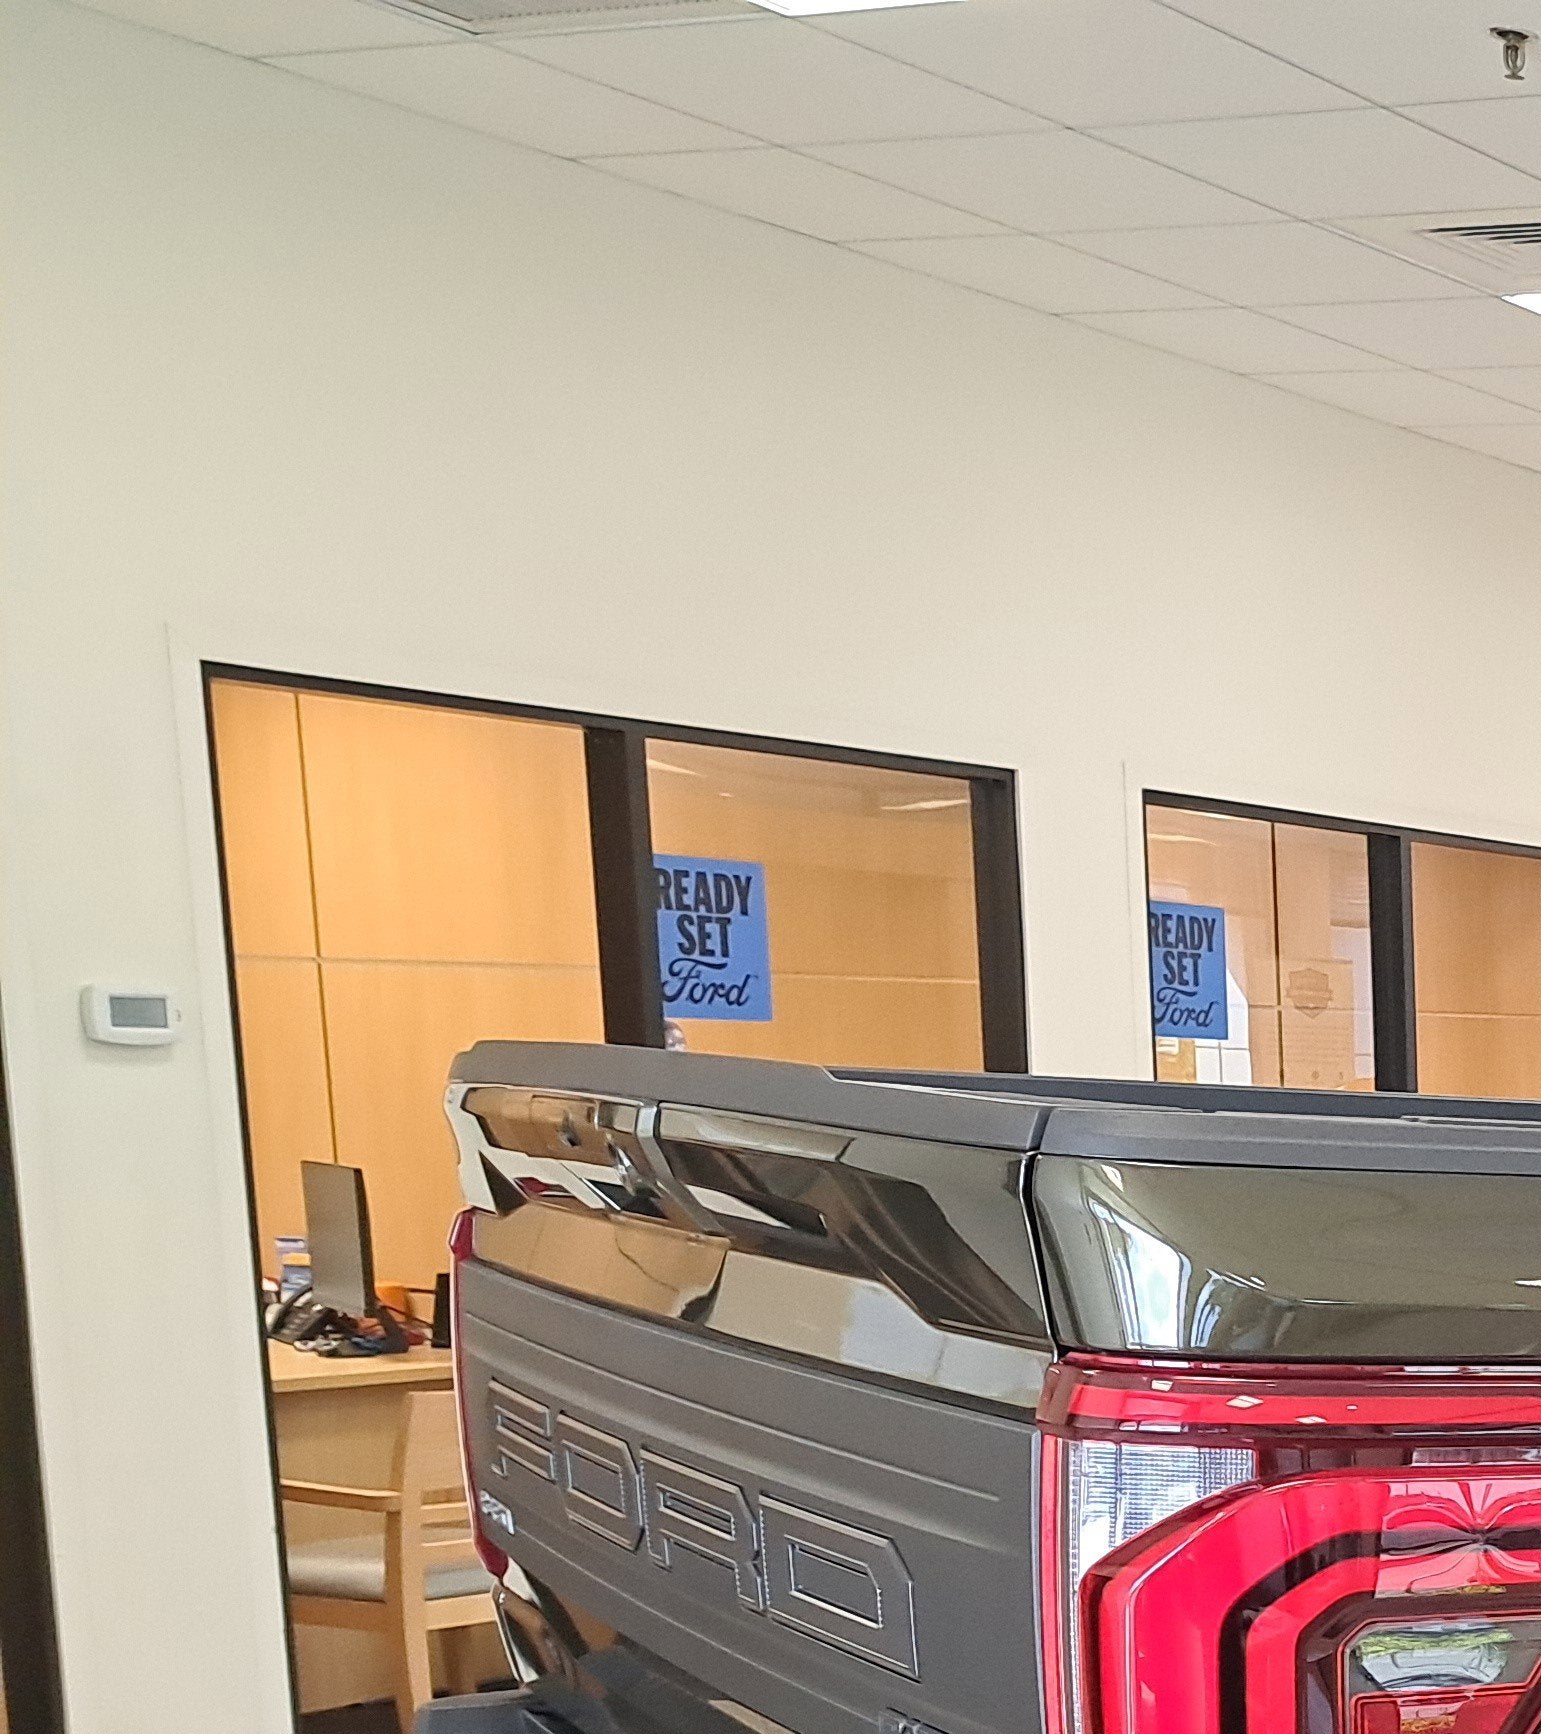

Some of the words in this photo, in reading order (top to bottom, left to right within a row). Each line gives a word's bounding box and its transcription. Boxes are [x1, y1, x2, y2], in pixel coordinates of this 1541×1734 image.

[654, 868, 752, 916] READY
[676, 913, 731, 958] SET
[1149, 912, 1216, 952] READY
[661, 957, 758, 1007] Ford
[1163, 950, 1201, 987] SET
[1154, 986, 1219, 1028] Ford
[488, 1376, 921, 1684] FORD
